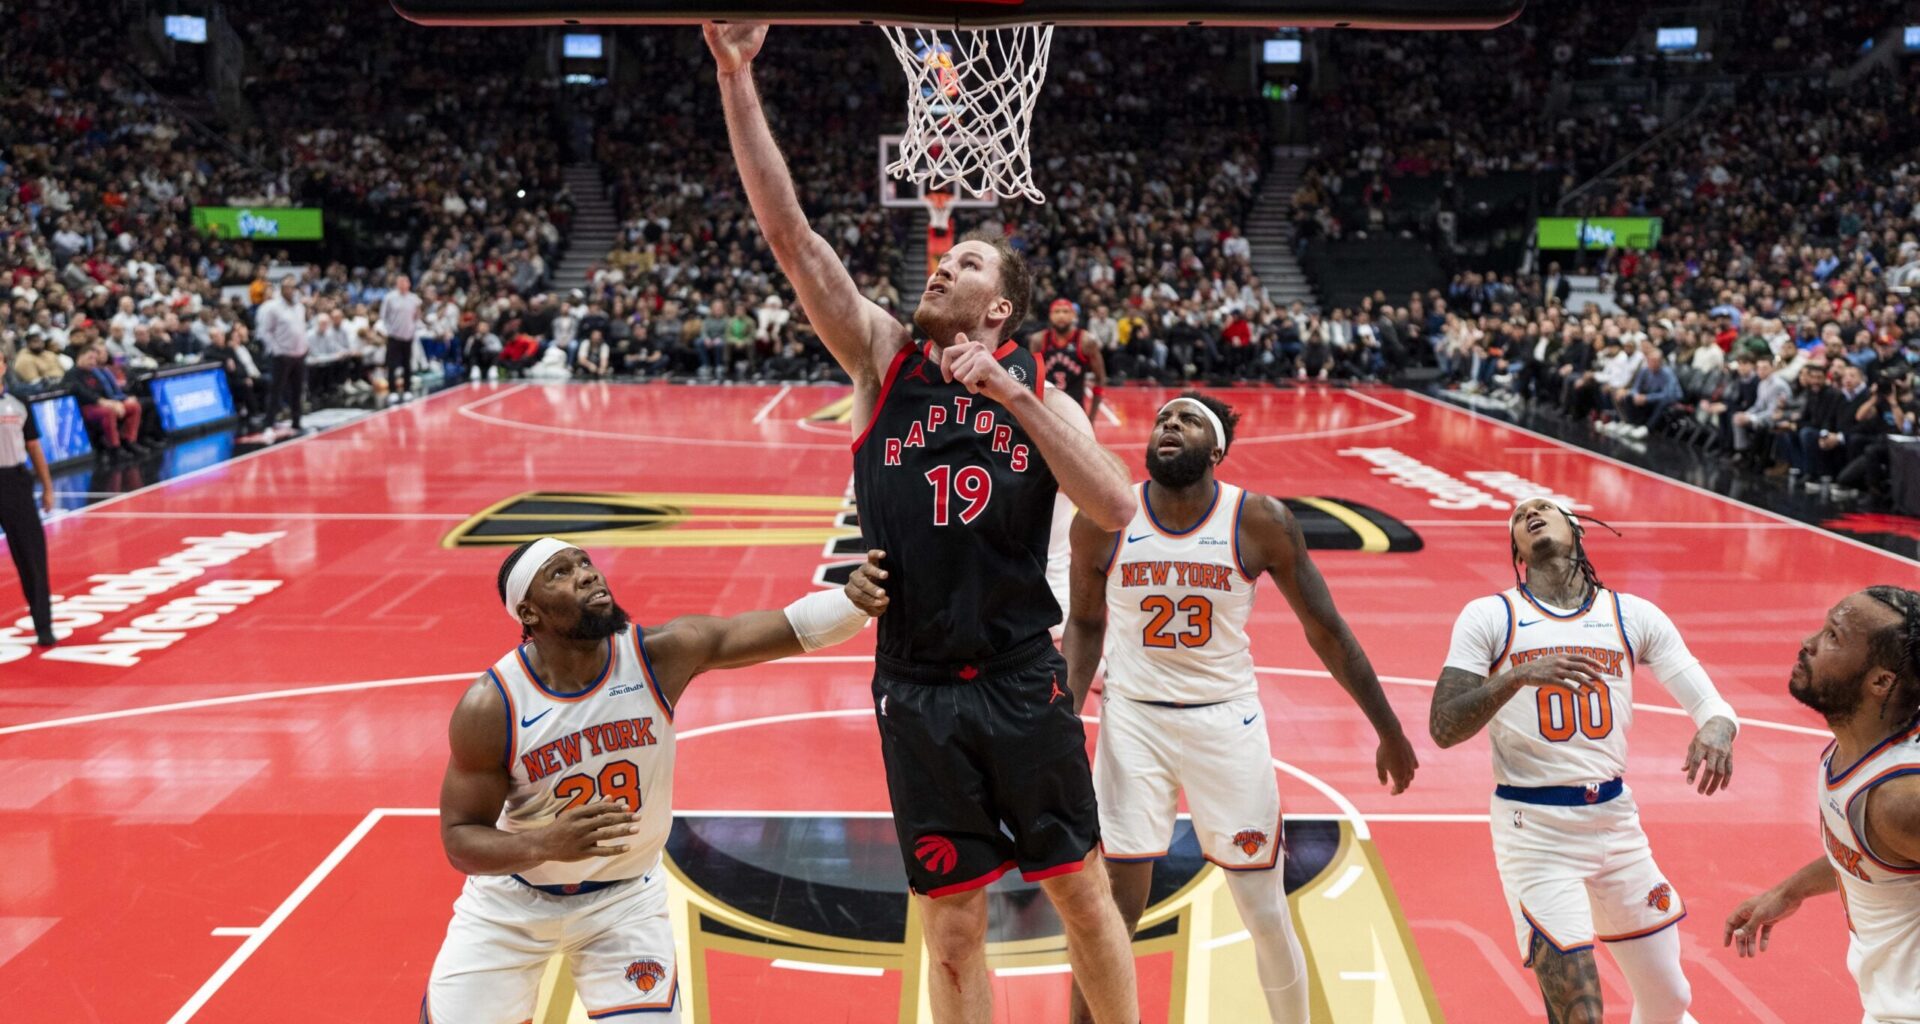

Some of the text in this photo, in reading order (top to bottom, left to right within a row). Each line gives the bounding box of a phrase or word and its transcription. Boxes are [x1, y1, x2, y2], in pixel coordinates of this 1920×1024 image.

[884, 396, 1029, 472] RAPTORS
[924, 464, 993, 526] 19
[1121, 561, 1233, 592] NEW YORK
[40, 579, 284, 667] Arena
[1140, 594, 1213, 649] 23
[609, 687, 623, 697] abu
[623, 681, 644, 694] dhabi
[1536, 678, 1614, 743] 00
[521, 716, 658, 784] NEW YORK
[554, 759, 642, 819] 28
